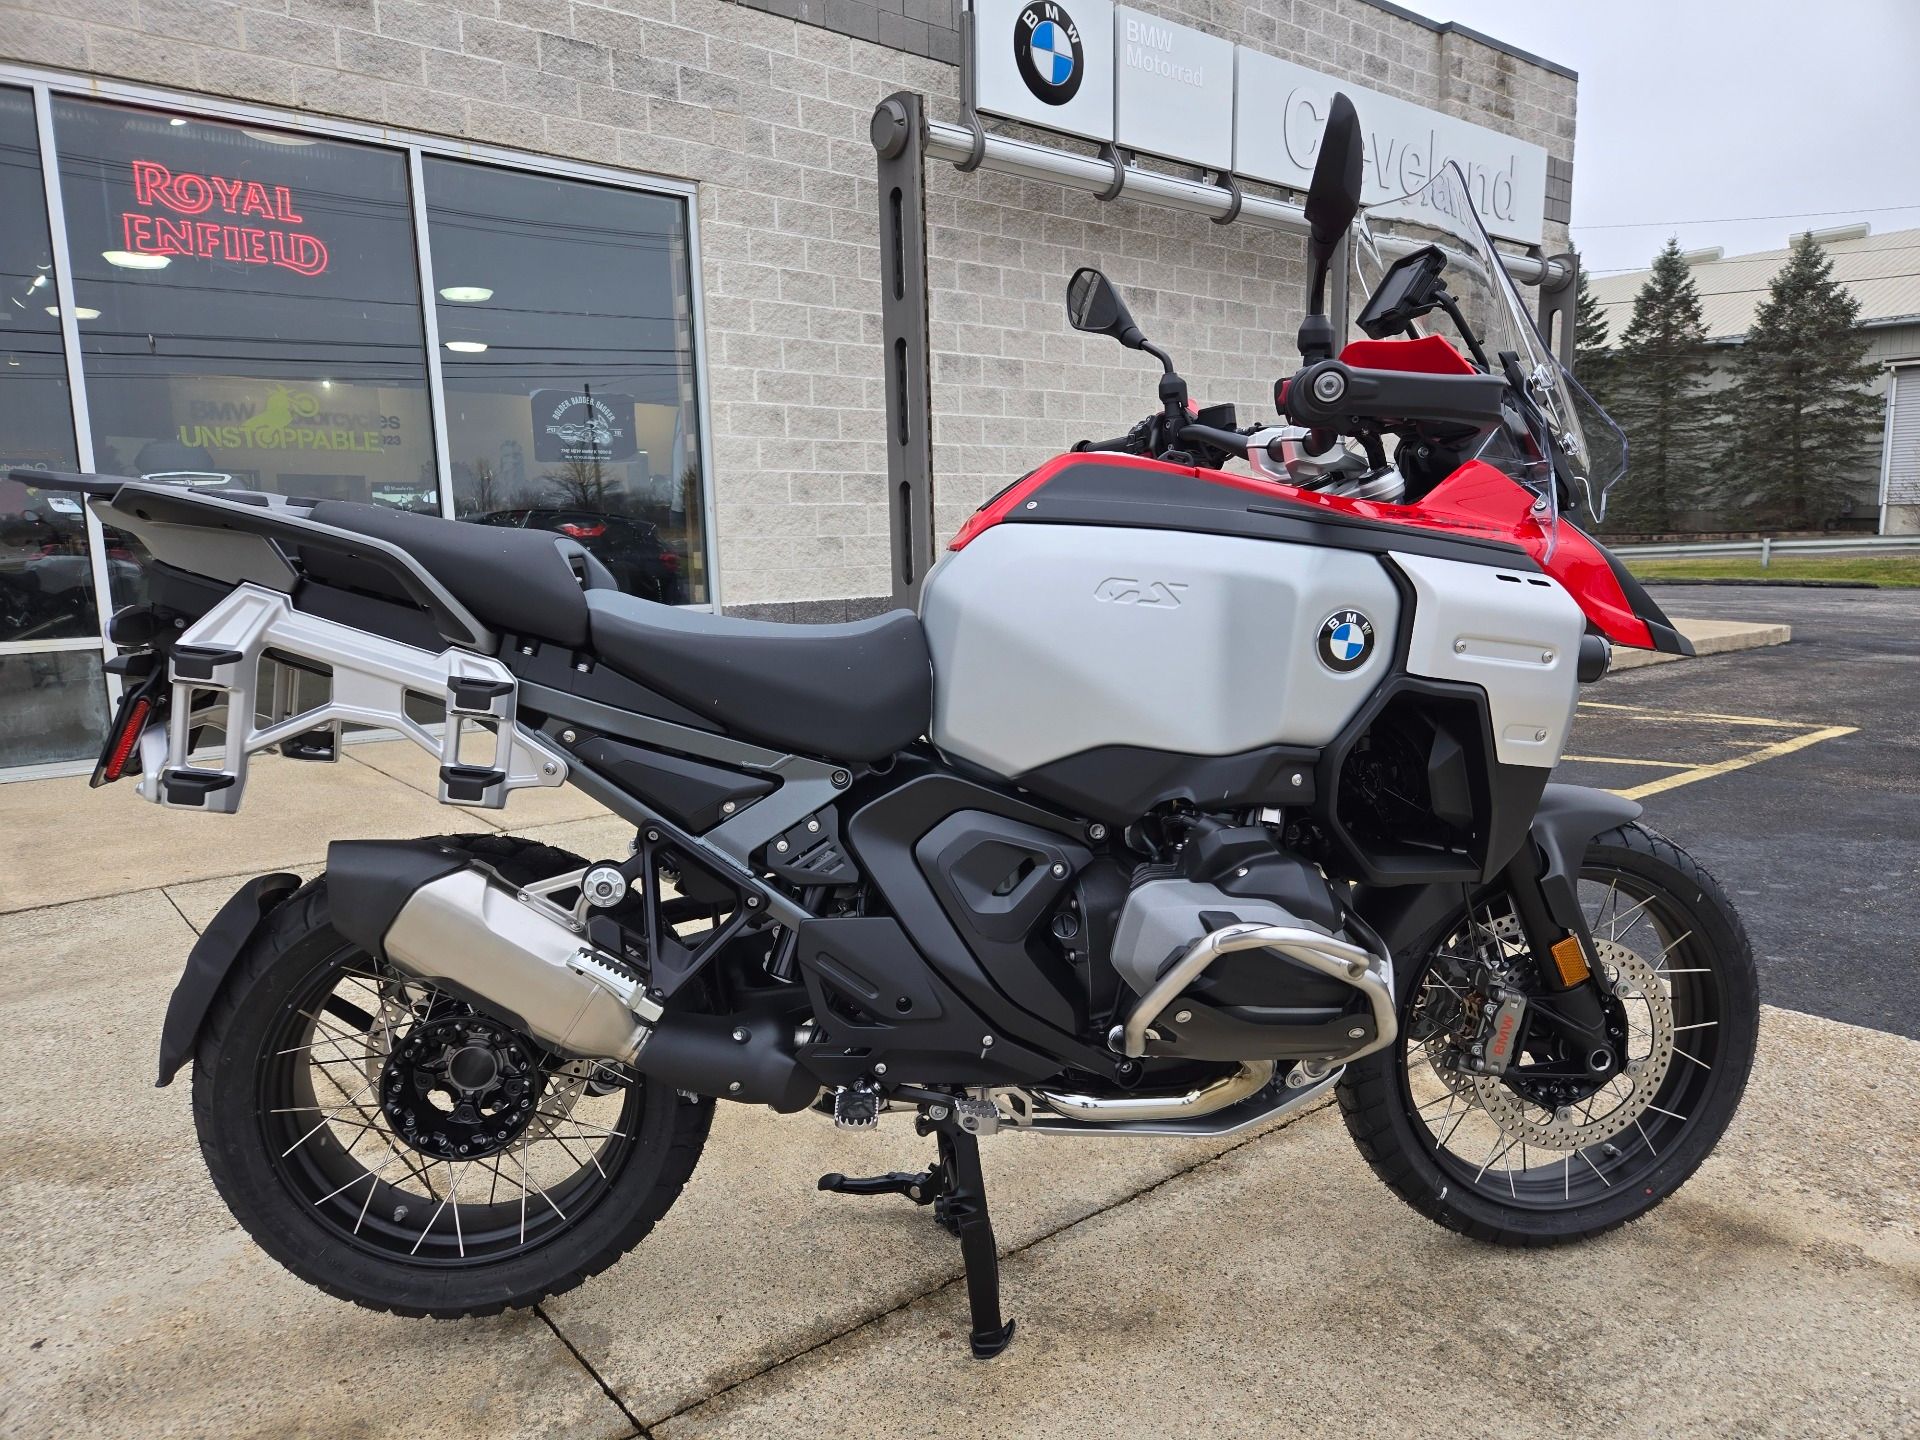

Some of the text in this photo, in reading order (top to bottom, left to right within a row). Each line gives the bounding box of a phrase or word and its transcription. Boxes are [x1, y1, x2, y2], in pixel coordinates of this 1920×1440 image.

[1022, 4, 1081, 44] BMW
[1126, 18, 1174, 53] BMW
[1126, 44, 1204, 88] Motorrad
[1284, 86, 1517, 223] Cveland
[132, 160, 303, 223] ROYAL
[122, 213, 328, 276] ENFIELD
[180, 425, 382, 451] UNSTOPPABLE
[1094, 577, 1188, 609] GS
[1327, 612, 1372, 635] BMW
[1493, 1015, 1514, 1056] BMW
